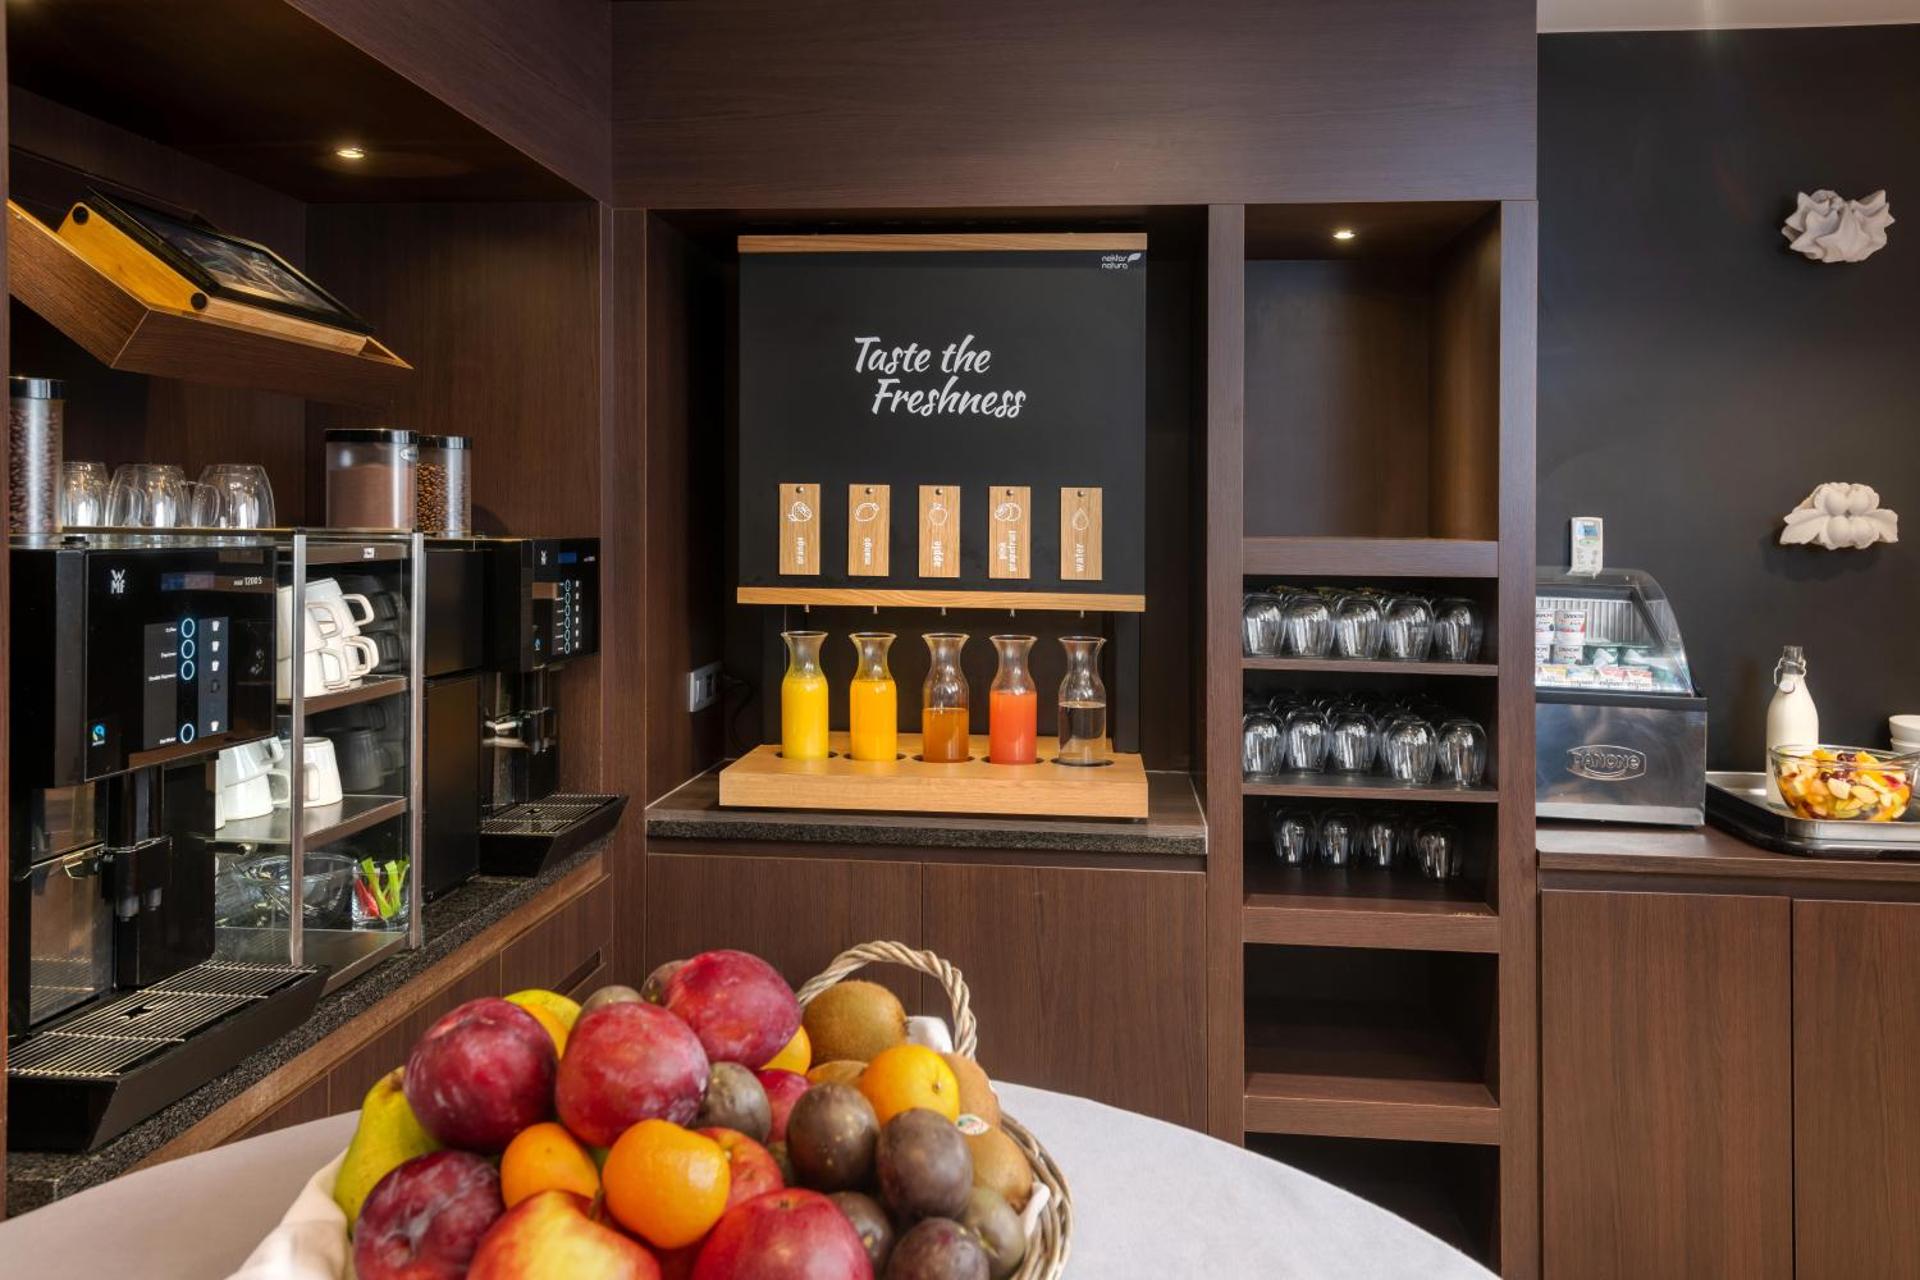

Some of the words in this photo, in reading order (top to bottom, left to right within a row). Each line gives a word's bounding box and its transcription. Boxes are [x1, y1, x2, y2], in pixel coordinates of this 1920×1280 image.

[854, 335, 932, 375] Taste
[940, 333, 992, 374] the
[871, 375, 1027, 419] Freshness
[797, 537, 806, 566] orange
[863, 537, 873, 566] mango
[932, 540, 944, 568] apple
[1008, 529, 1018, 572] grapefruit
[1075, 543, 1085, 573] water
